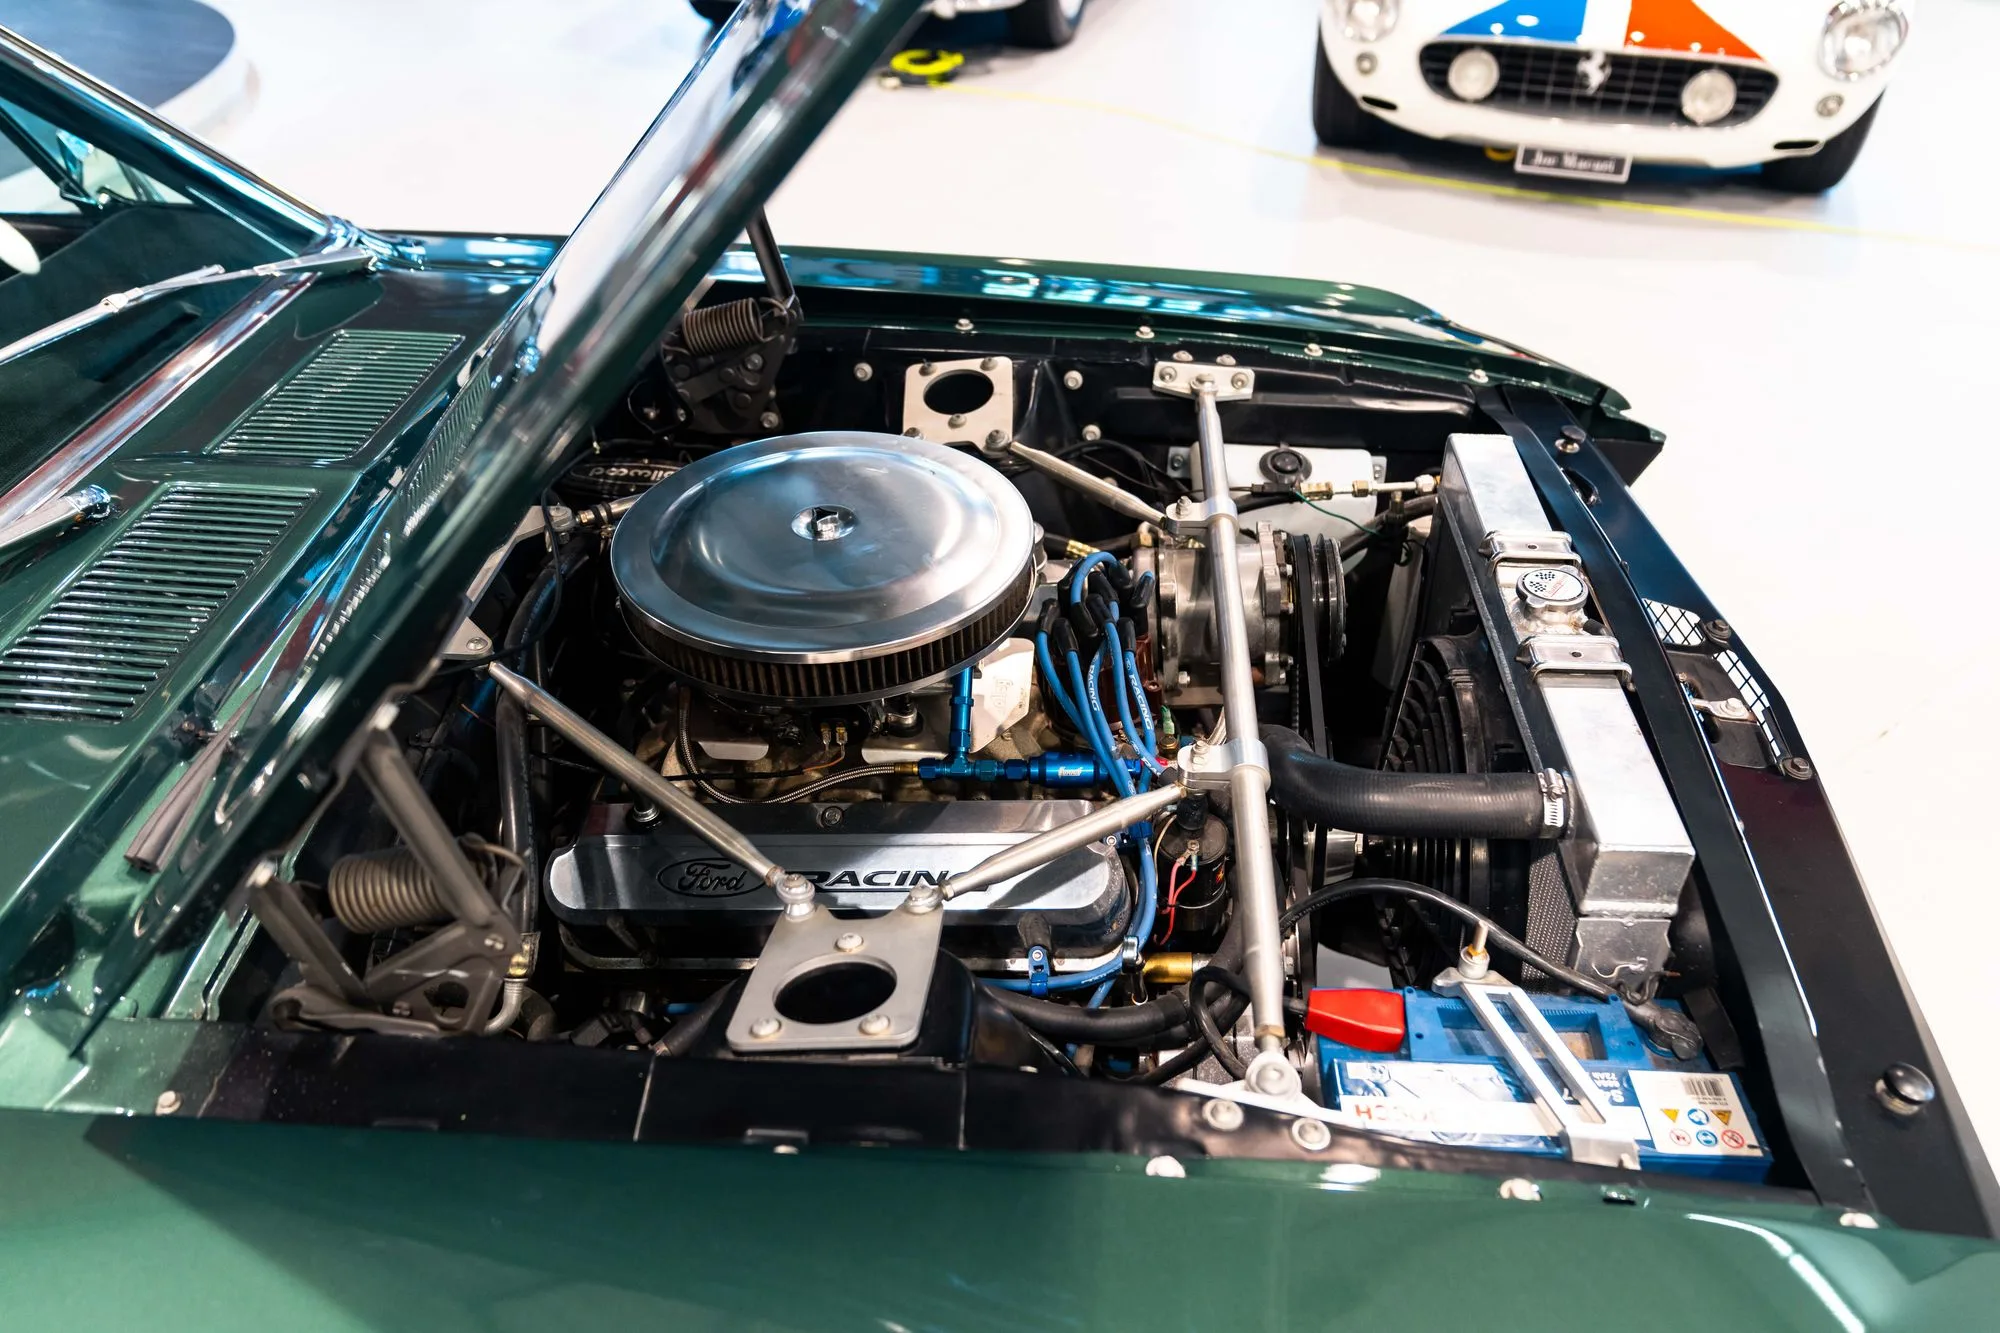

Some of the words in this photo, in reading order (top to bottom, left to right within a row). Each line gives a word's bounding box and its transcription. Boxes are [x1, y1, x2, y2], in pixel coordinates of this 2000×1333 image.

[1087, 664, 1100, 712] RACING
[1129, 674, 1153, 731] RACING
[678, 861, 748, 891] Ford
[785, 870, 964, 888] RACIN
